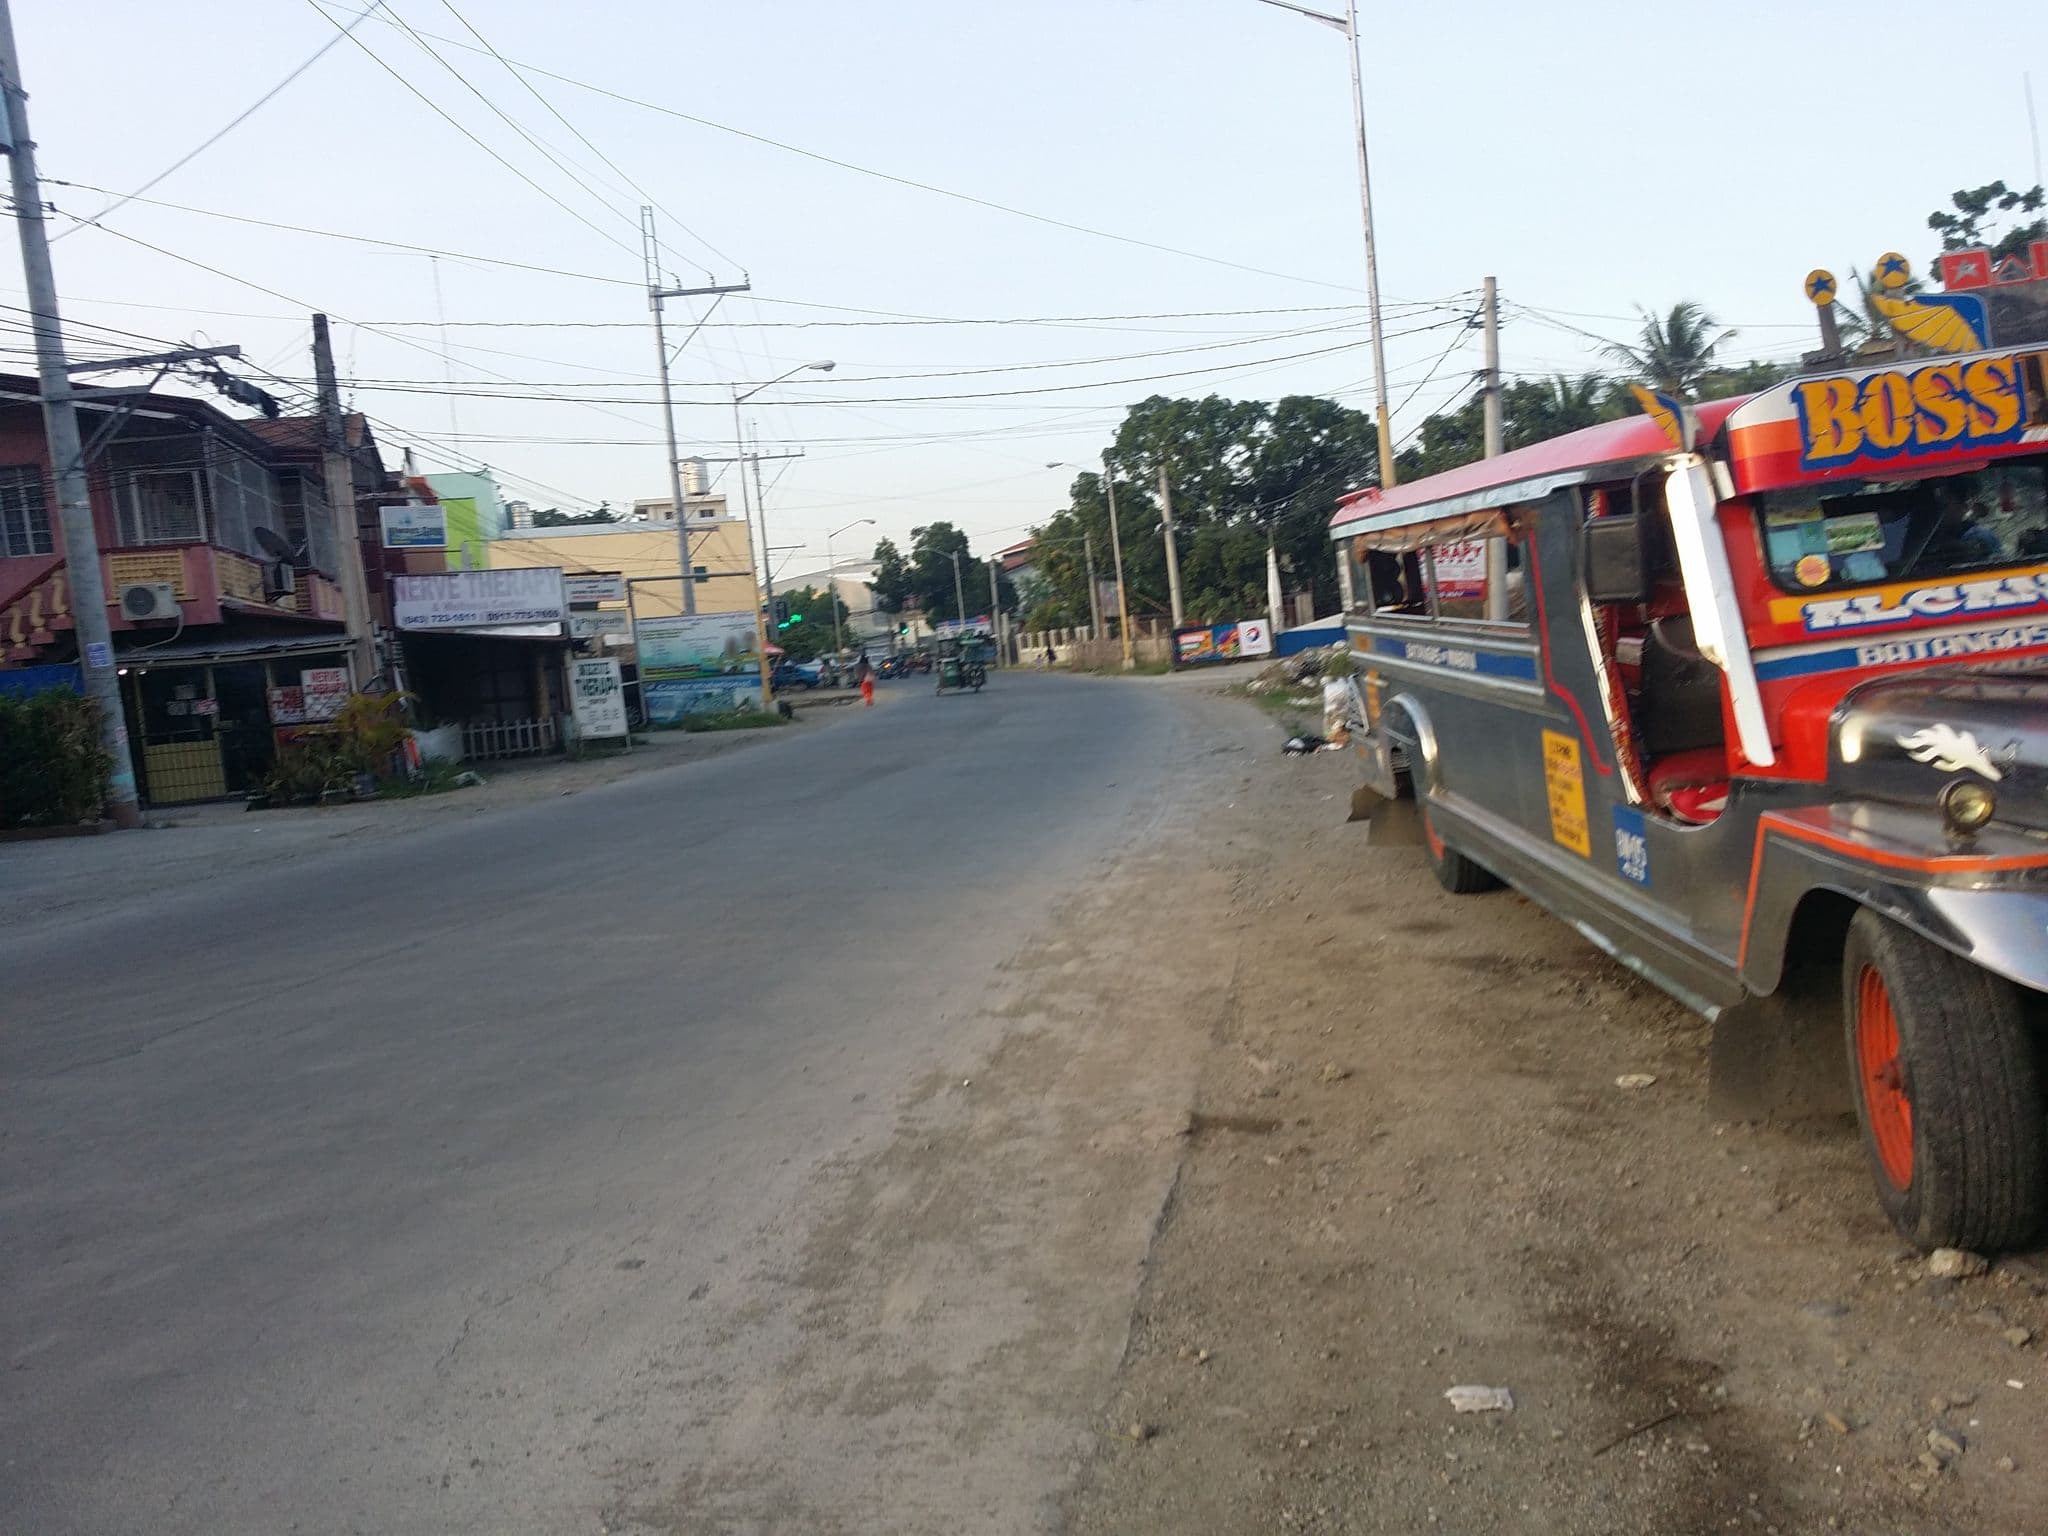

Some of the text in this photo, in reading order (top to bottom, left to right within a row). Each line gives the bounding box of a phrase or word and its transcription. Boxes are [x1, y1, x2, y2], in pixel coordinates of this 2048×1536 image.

[1796, 353, 2022, 464] BOSS
[395, 567, 560, 600] NERVE THERAPY
[1857, 626, 2048, 667] BATANGAS
